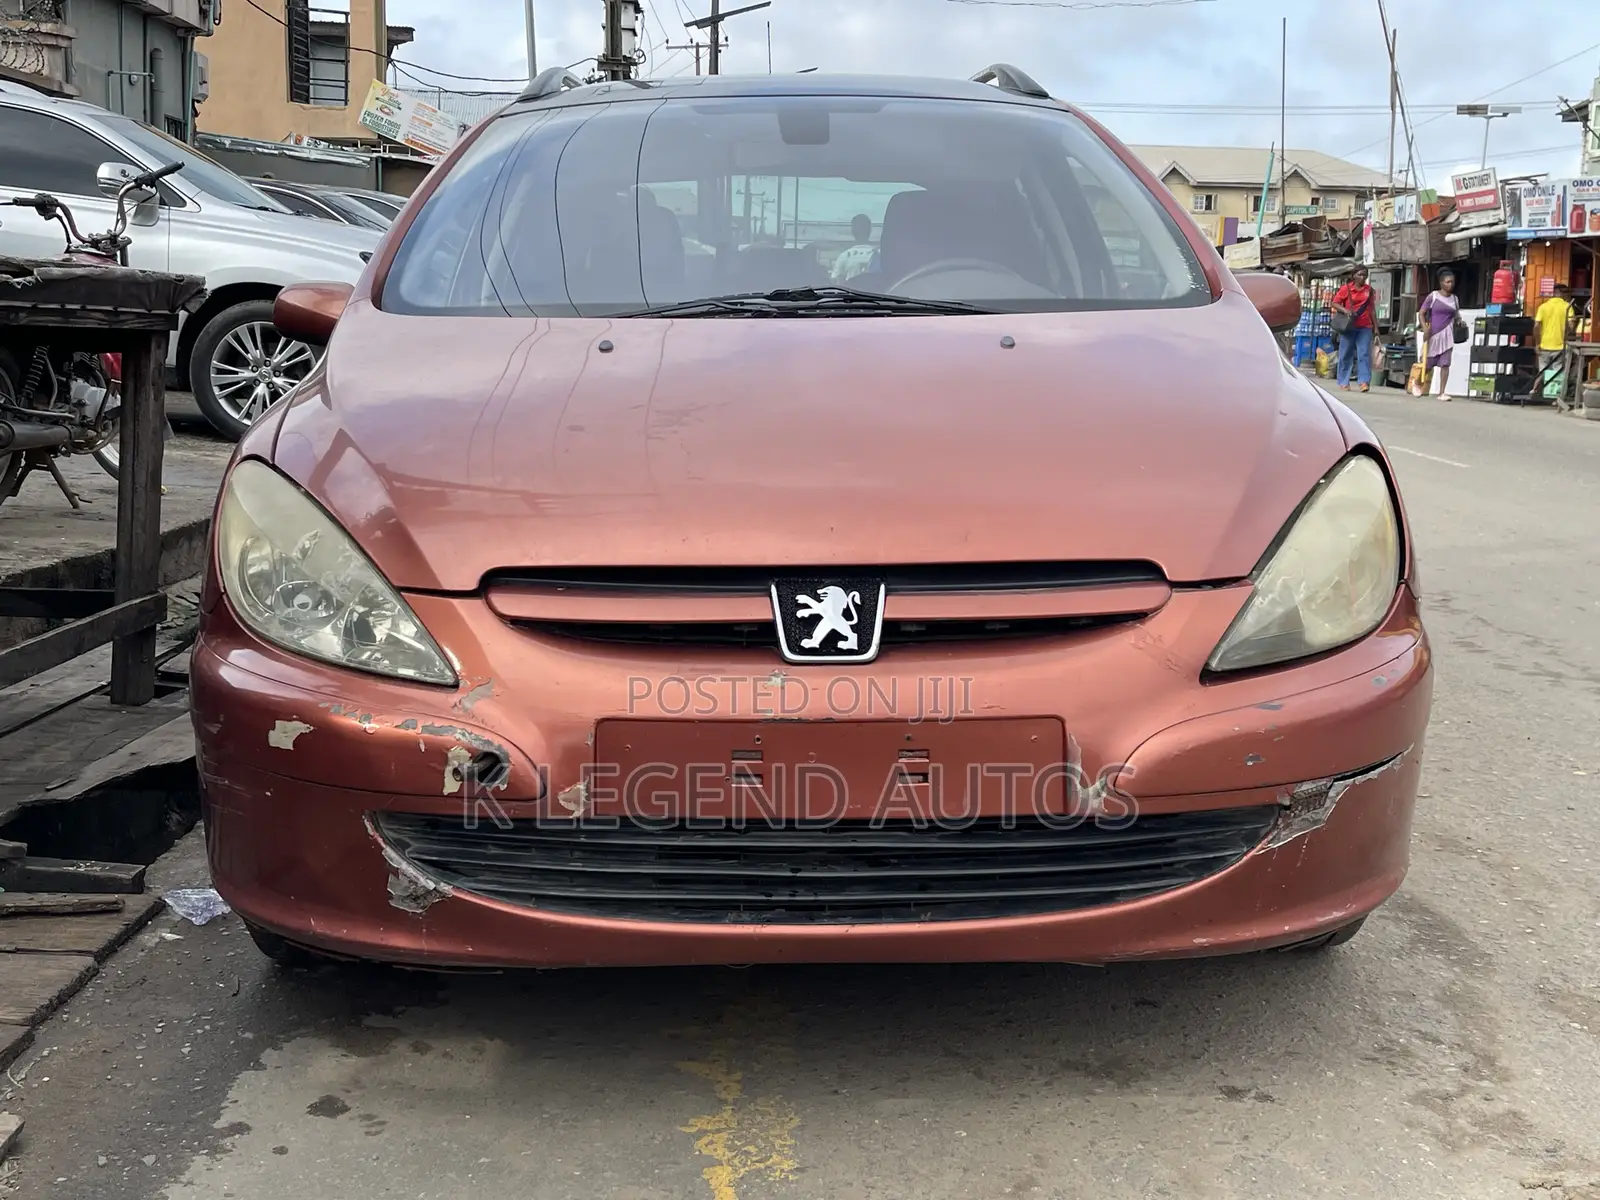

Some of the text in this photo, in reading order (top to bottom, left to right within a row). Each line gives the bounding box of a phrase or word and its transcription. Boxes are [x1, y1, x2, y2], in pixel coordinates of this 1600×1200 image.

[364, 110, 385, 123] FROZEN
[384, 117, 401, 130] FOODS
[368, 120, 399, 136] FOODSTUFFS
[1572, 179, 1593, 188] OMO
[1523, 185, 1556, 198] OMO ONILE
